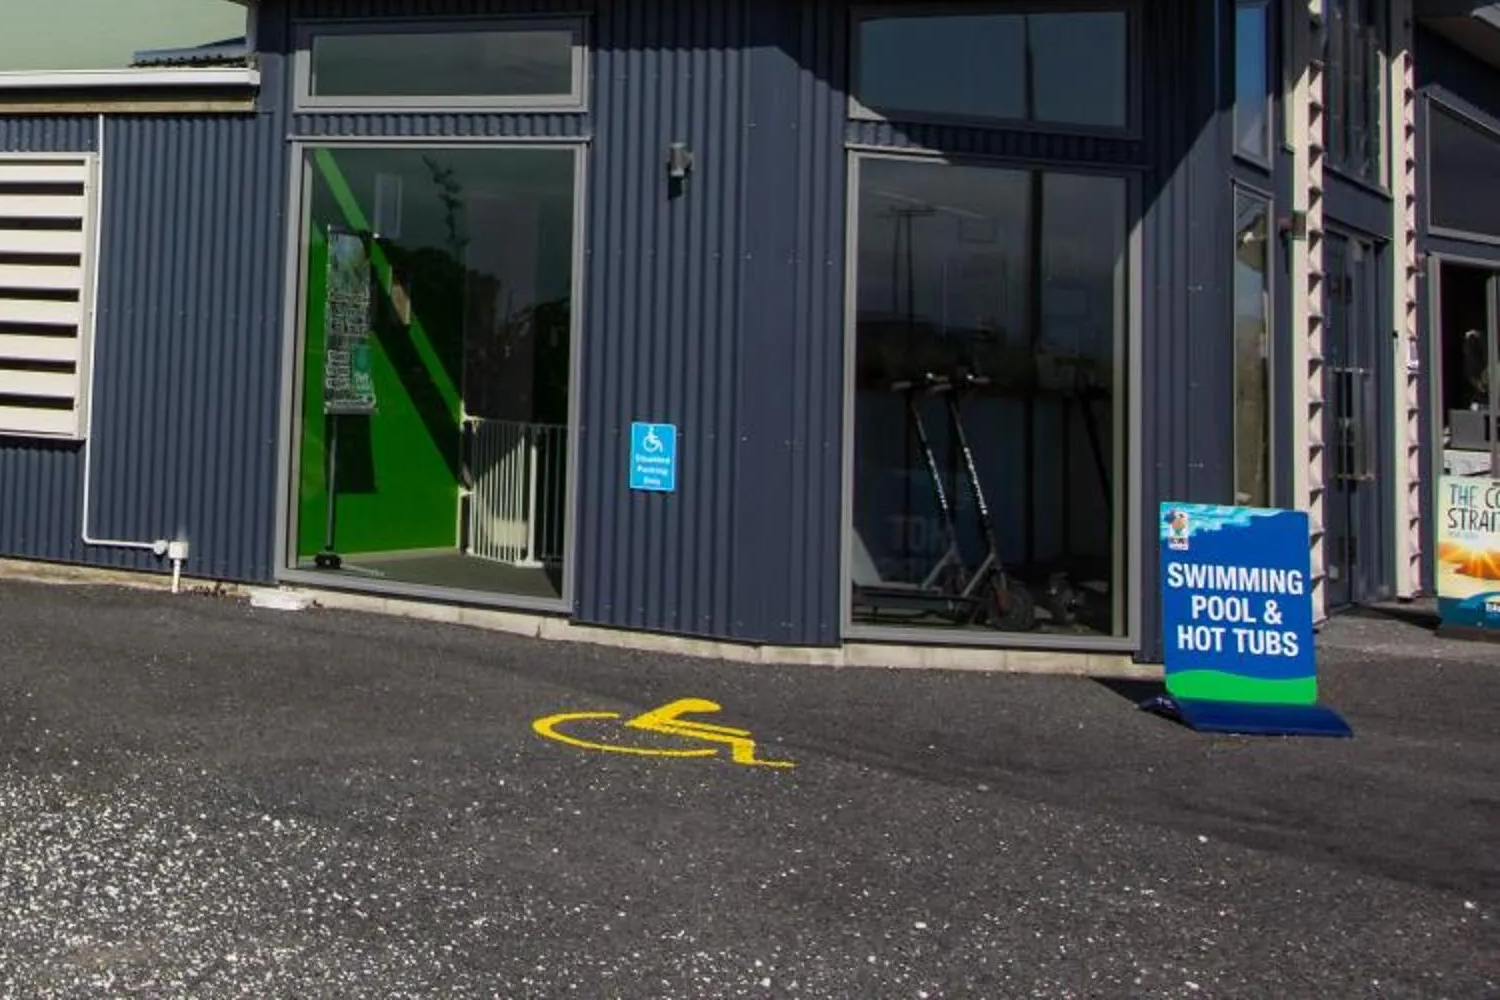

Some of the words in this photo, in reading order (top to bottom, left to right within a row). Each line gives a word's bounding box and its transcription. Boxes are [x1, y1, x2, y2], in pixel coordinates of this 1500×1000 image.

[1449, 484, 1479, 507] THE
[1167, 562, 1303, 595] SWIMMING
[1191, 594, 1257, 624] POOL
[1263, 600, 1283, 625] &
[1177, 625, 1226, 651] HOT
[1232, 628, 1299, 657] TUBS
